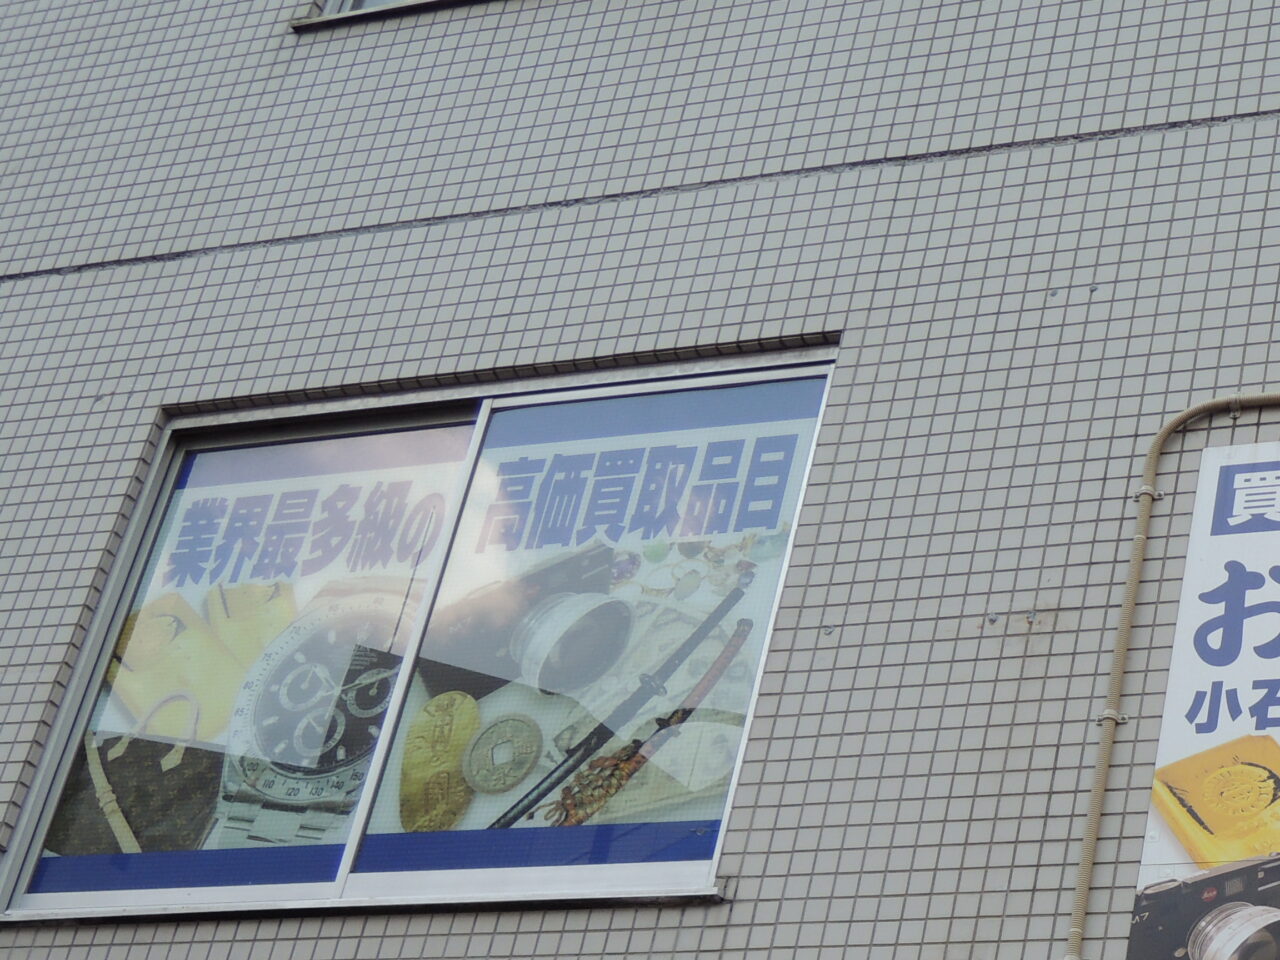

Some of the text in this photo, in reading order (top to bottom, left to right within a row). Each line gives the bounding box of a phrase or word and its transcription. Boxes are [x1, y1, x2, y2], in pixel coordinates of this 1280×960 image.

[162, 480, 446, 588] 業界最多級の
[475, 433, 799, 553] 高価買取品目
